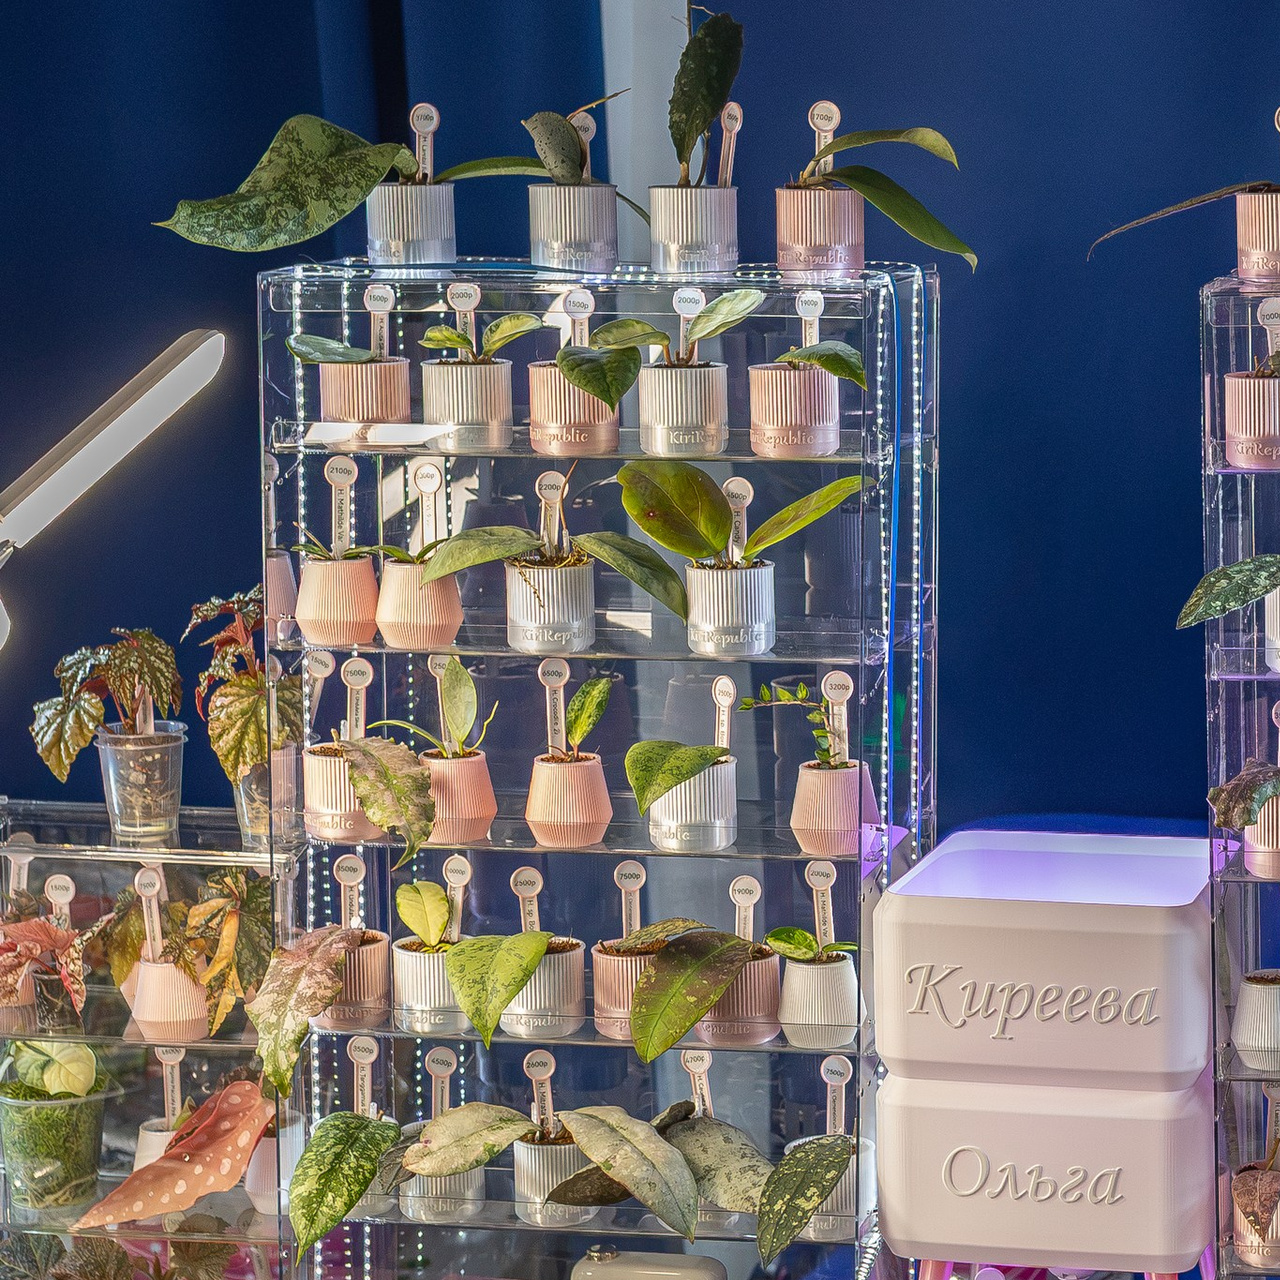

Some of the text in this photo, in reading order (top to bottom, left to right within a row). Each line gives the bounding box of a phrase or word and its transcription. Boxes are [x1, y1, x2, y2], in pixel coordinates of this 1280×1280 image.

[733, 521, 741, 543] Candy
[905, 963, 1160, 1040] Киреева
[942, 1145, 1125, 1204] Ольга
